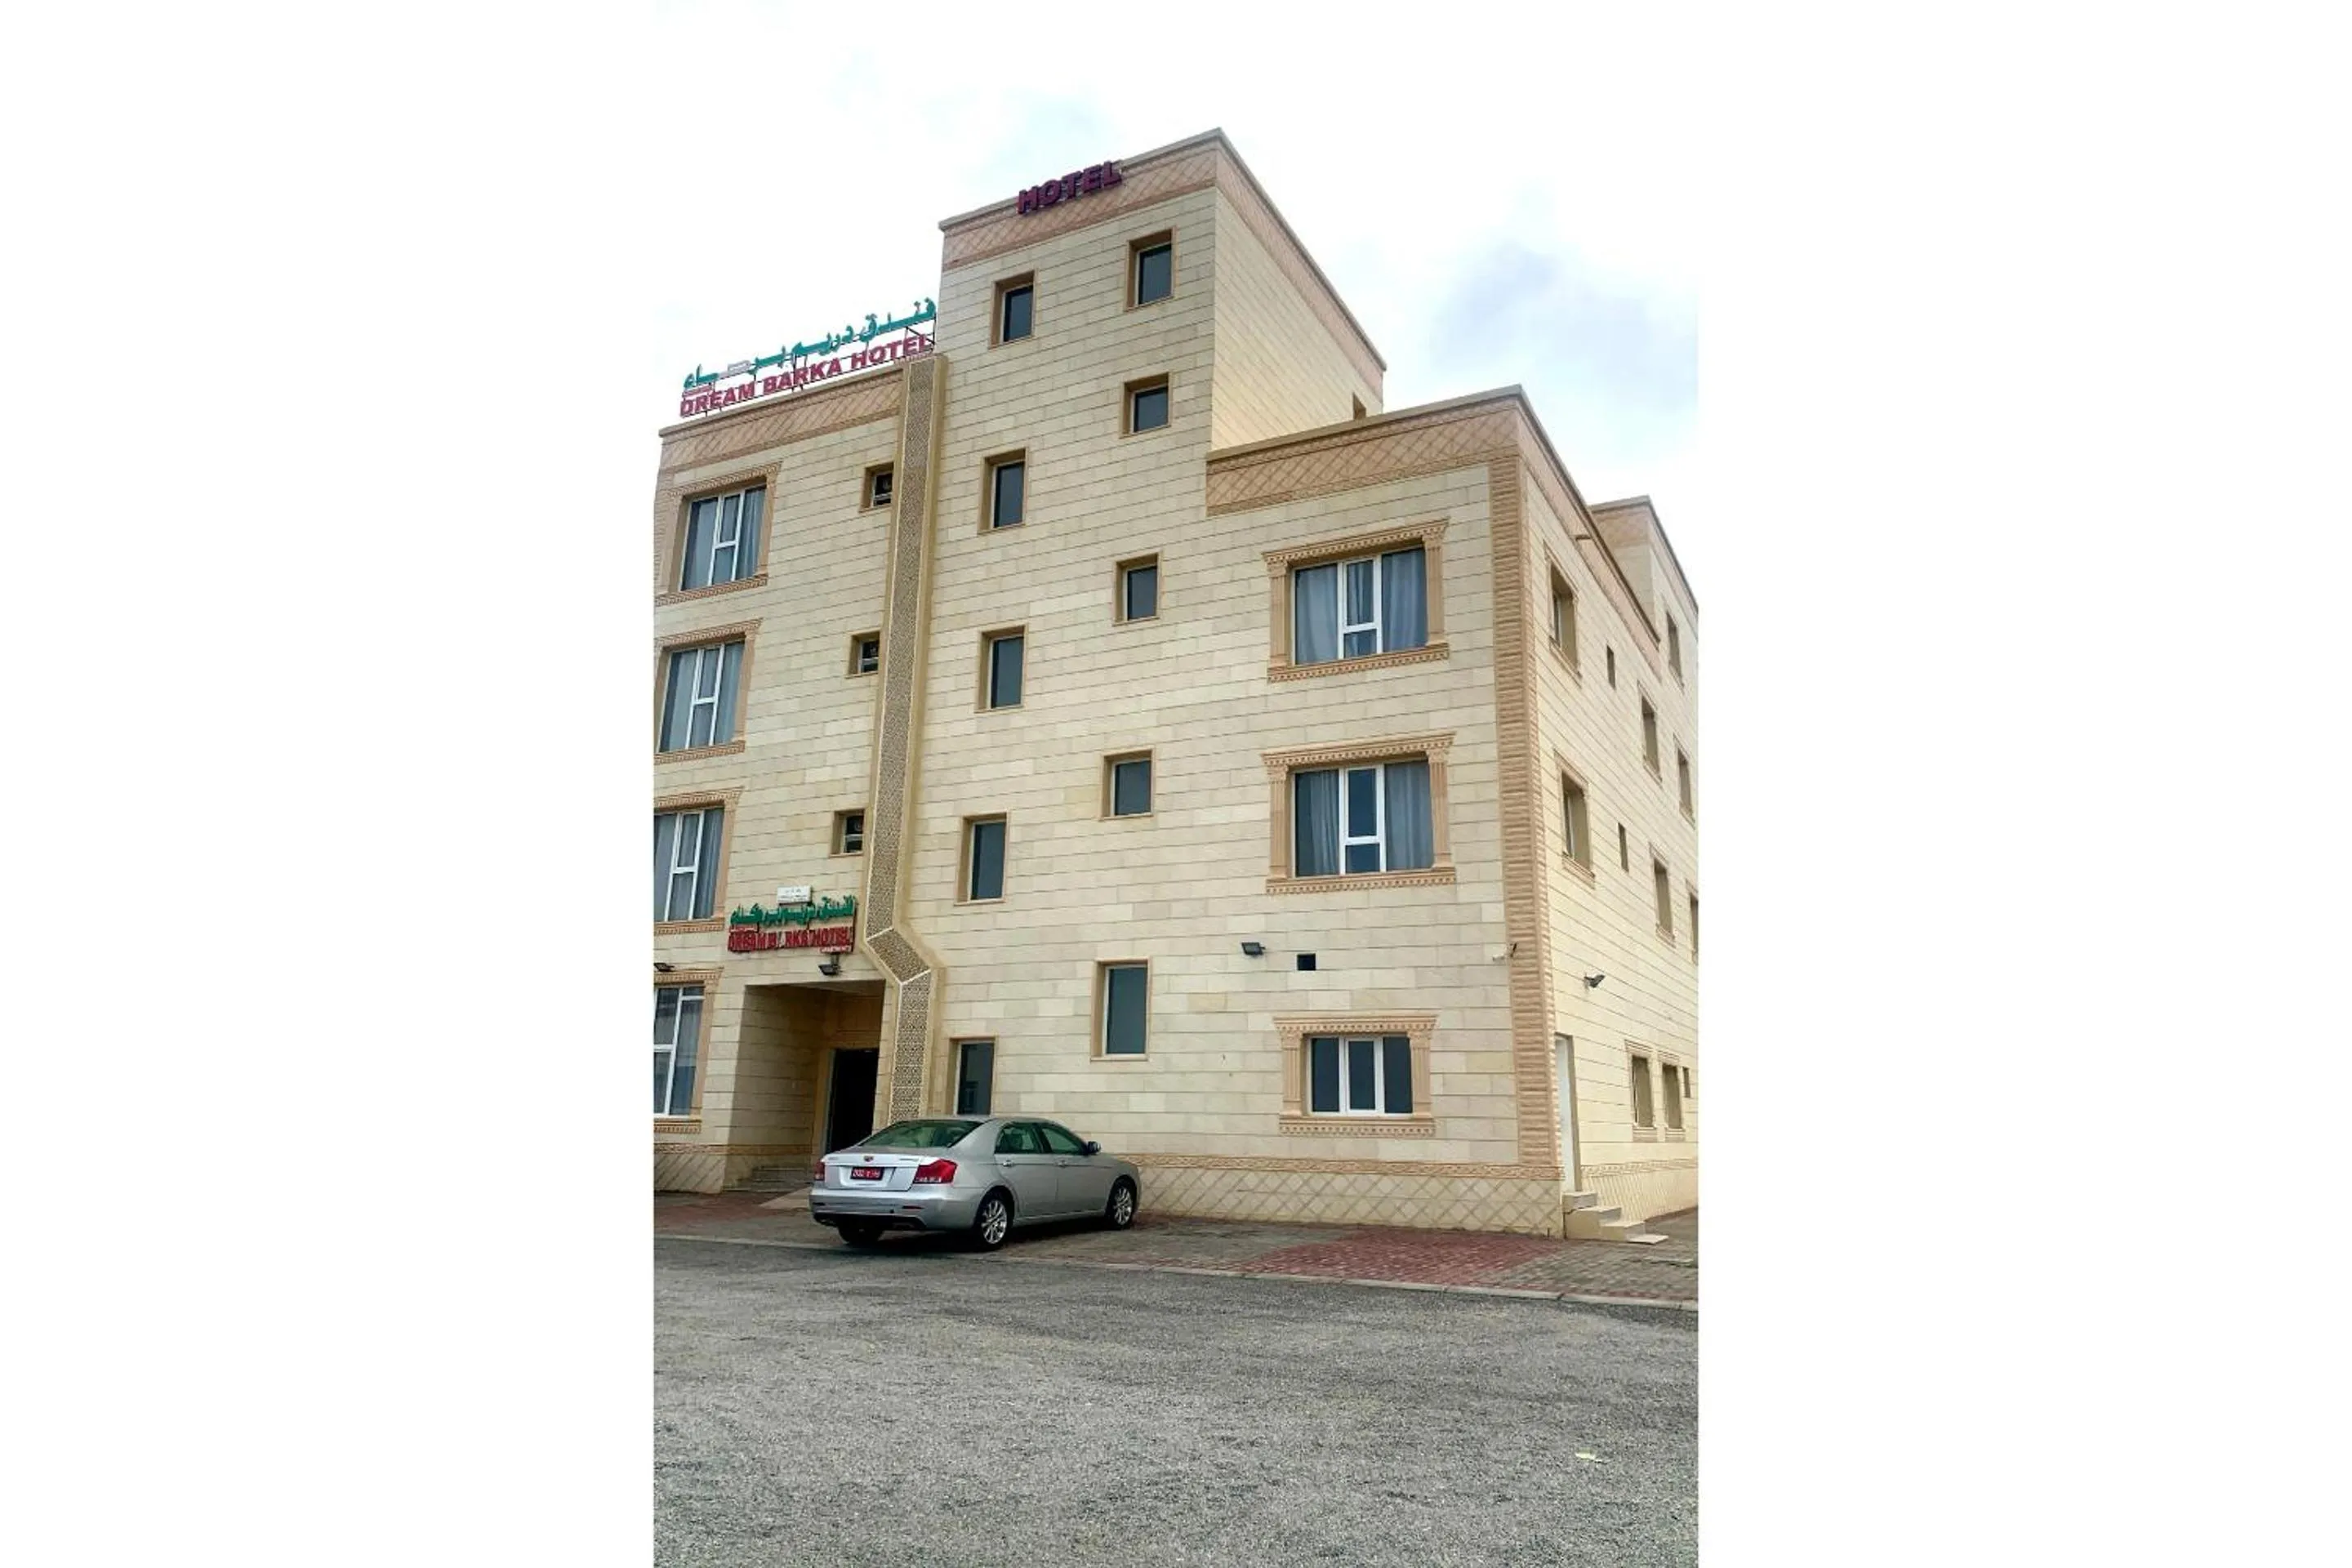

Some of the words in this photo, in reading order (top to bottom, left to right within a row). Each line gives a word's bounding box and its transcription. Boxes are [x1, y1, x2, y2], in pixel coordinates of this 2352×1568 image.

[1018, 161, 1122, 214] HOTEL
[679, 378, 755, 418] DREAM
[763, 358, 842, 396] BARKA
[851, 334, 932, 369] HOTEL
[768, 929, 808, 949] BRKA
